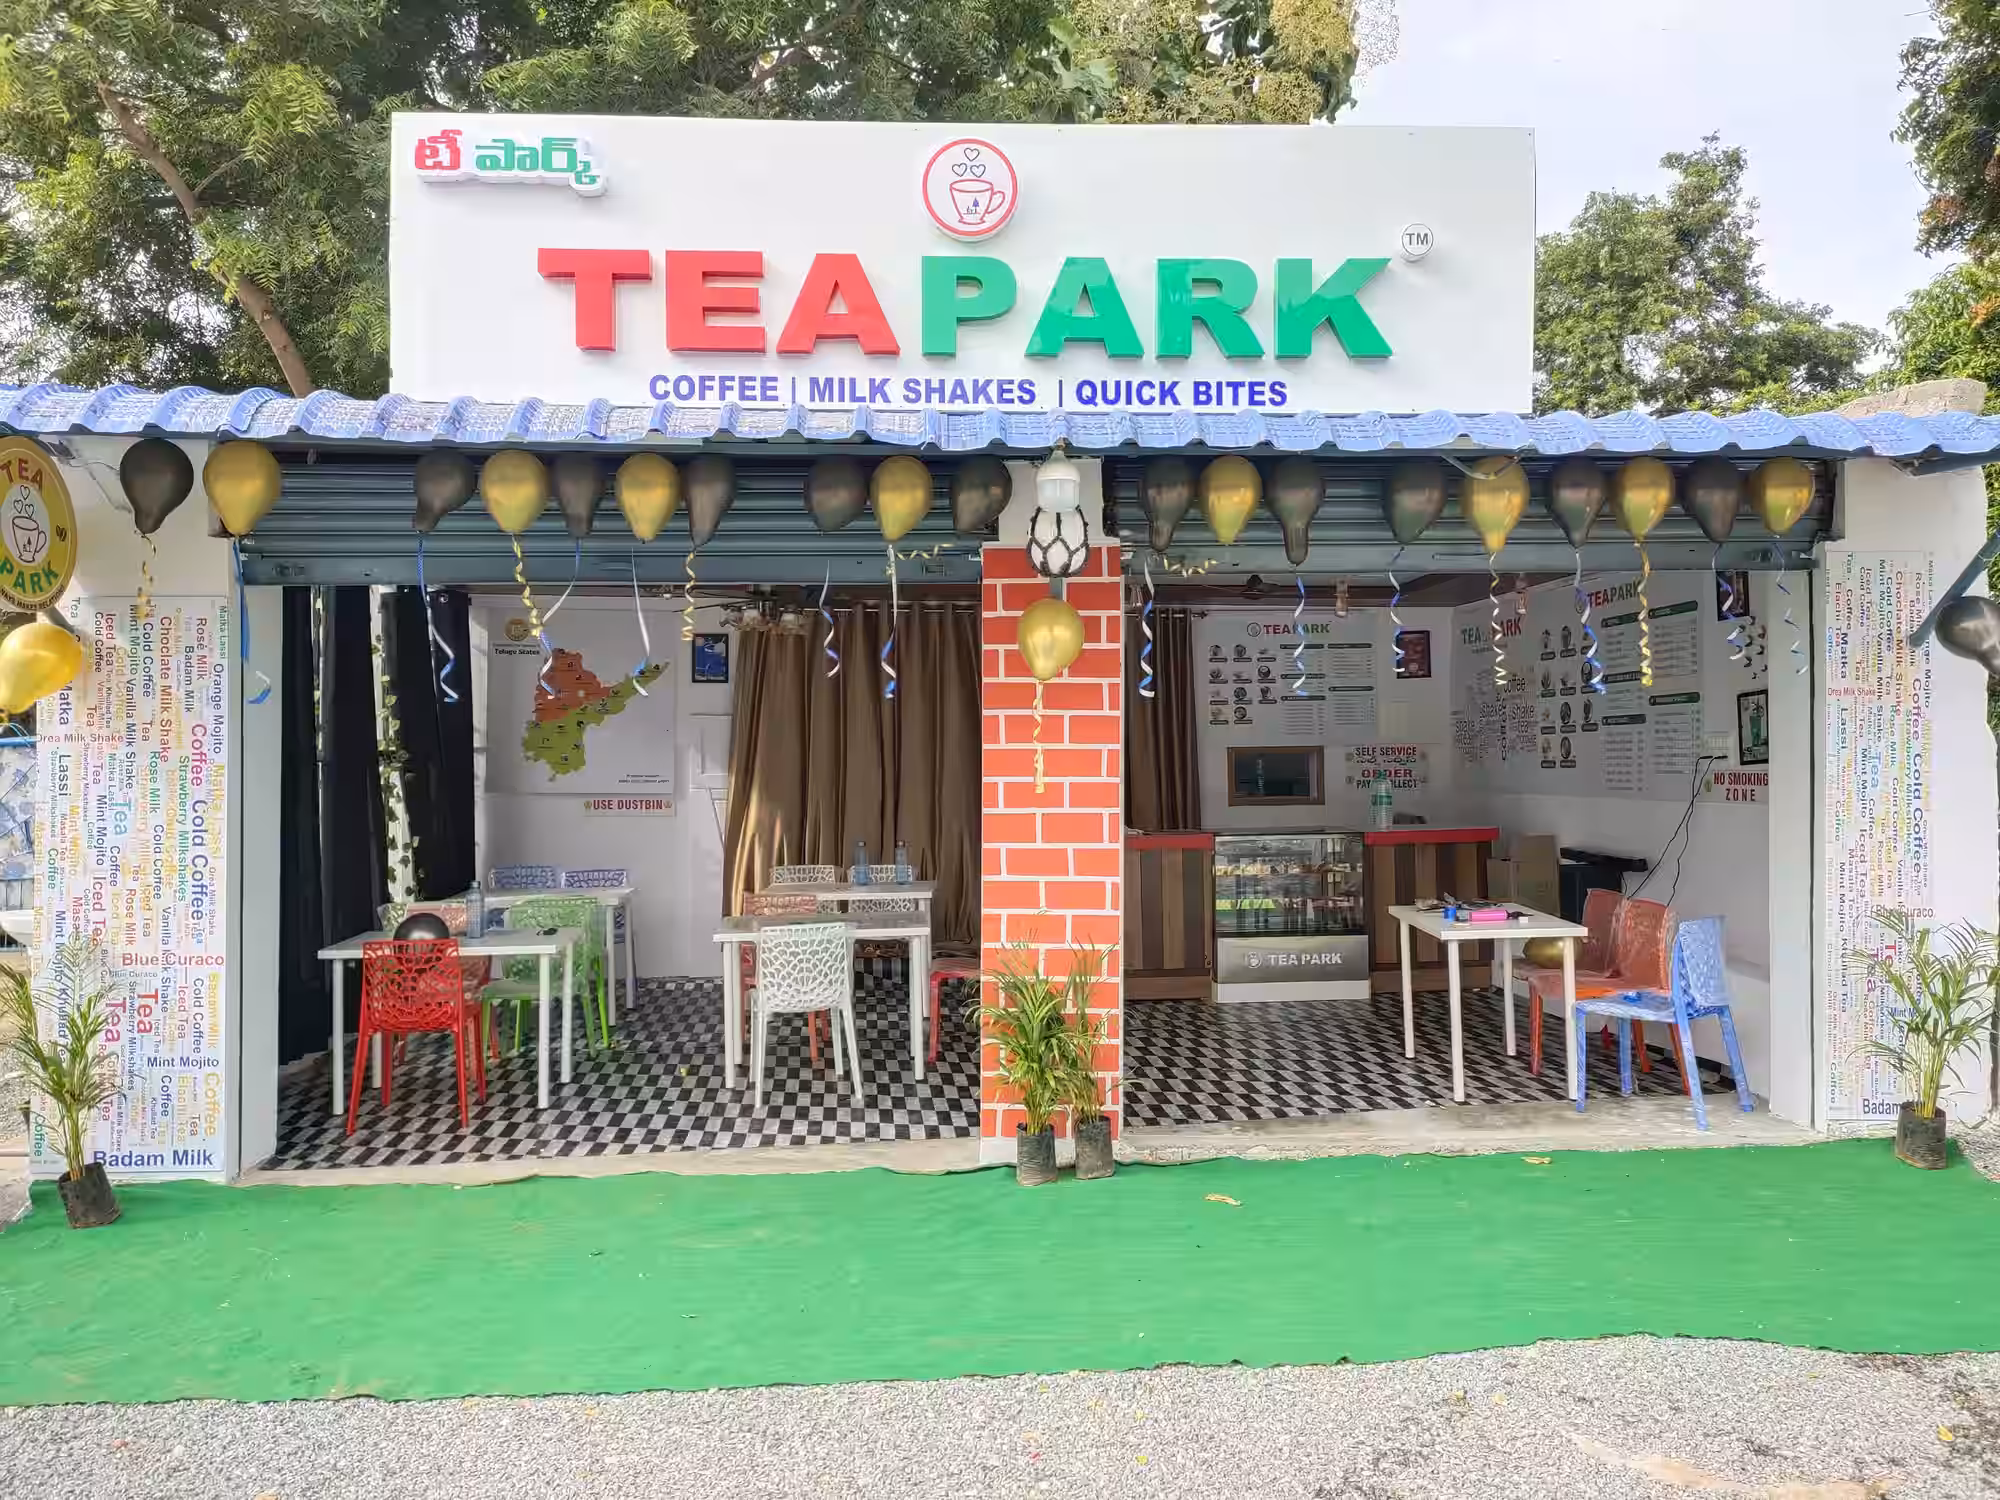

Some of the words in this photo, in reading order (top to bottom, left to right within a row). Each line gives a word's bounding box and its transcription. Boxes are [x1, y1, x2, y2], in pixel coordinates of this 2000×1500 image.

[414, 129, 462, 170] టీ
[1406, 232, 1429, 246] TM
[650, 374, 779, 401] COFFEE
[809, 376, 892, 403] MILK
[902, 378, 1036, 404] SHAKES
[1076, 380, 1180, 407] QUICK
[1193, 381, 1288, 406] BITES
[0, 458, 43, 494] TEA
[0, 559, 59, 594] PARK
[95, 612, 103, 636] Cold
[106, 614, 116, 639] Iced
[143, 623, 153, 652] Cold
[95, 640, 103, 672] Coffee
[106, 645, 116, 666] Tea
[128, 636, 140, 675] Mojito
[160, 617, 172, 679] Choclate
[1895, 639, 1903, 667] Milk
[143, 656, 153, 697] Coffee
[184, 645, 194, 686] Badam
[197, 655, 206, 680] Milk
[126, 678, 136, 718] Vanilla
[160, 685, 172, 714] Milk
[184, 690, 194, 713] Milk
[211, 664, 224, 710] Orange
[1895, 673, 1903, 717] Shake
[86, 706, 96, 727] Tea
[1912, 678, 1921, 742] Coffee
[64, 734, 86, 743] Milk
[89, 734, 124, 743] Shake
[126, 723, 136, 747] Milk
[142, 720, 152, 741] Tea
[160, 719, 172, 762] Shake
[211, 715, 224, 753] Mojito
[149, 751, 160, 783] Rose
[191, 724, 207, 787] Coffee
[1355, 747, 1377, 756] SELF
[1380, 747, 1417, 756] SERVICE
[59, 754, 71, 796] Lassi
[93, 762, 103, 784] Tea
[108, 753, 116, 782] Matka
[126, 752, 136, 789] Shake
[1713, 772, 1725, 785] NO
[1728, 772, 1769, 786] SMOKING
[1871, 752, 1881, 788] Tea
[1913, 753, 1923, 800] Cold
[108, 785, 116, 811] Lassi
[176, 755, 189, 825] Strawberry
[1356, 780, 1371, 789] PAY
[1725, 788, 1756, 802] ZONE
[96, 795, 106, 821] Mint
[149, 788, 160, 814] Milk
[593, 800, 613, 810] USE
[617, 800, 663, 810] DUSTBIN
[113, 798, 132, 836] Tea
[191, 800, 208, 847] Cold
[94, 826, 106, 866] Mojito
[153, 825, 164, 853] Cold
[1859, 829, 1867, 864] Iced
[1913, 808, 1923, 874] Coffee
[48, 848, 58, 889] Coffee
[110, 845, 120, 887] Coffee
[132, 864, 140, 882] Tea
[178, 830, 189, 902] Milkshakes
[93, 877, 106, 911] Iced
[191, 855, 208, 920] Coffee
[1859, 870, 1867, 898] Tea
[125, 888, 136, 918] Rose
[56, 910, 65, 938] Mint
[93, 918, 106, 946] Tea
[125, 923, 136, 946] Milk
[143, 917, 153, 937] Tea
[161, 907, 171, 945] Vanilla
[122, 952, 160, 966] Blue
[165, 952, 224, 966] Curaco
[1267, 954, 1298, 966] TEA
[1301, 953, 1342, 965] PARK
[127, 981, 136, 1034] Strawberry
[161, 977, 171, 1012] Shake
[178, 986, 188, 1012] Iced
[193, 978, 204, 1007] Cold
[105, 997, 126, 1042] Tea
[137, 988, 158, 1035] Tea
[178, 1017, 188, 1039] Tea
[193, 1012, 204, 1053] Coffee
[127, 1037, 136, 1091] Milkshakes
[147, 1056, 175, 1067] Mint
[179, 1056, 219, 1069] Mojito
[102, 1099, 113, 1121] Tea
[161, 1075, 171, 1117] Coffee
[205, 1072, 219, 1137] Coffee
[1862, 1098, 1900, 1114] Badam
[190, 1114, 200, 1136] Tea
[94, 1151, 164, 1167] Badam
[172, 1150, 213, 1166] Milk
